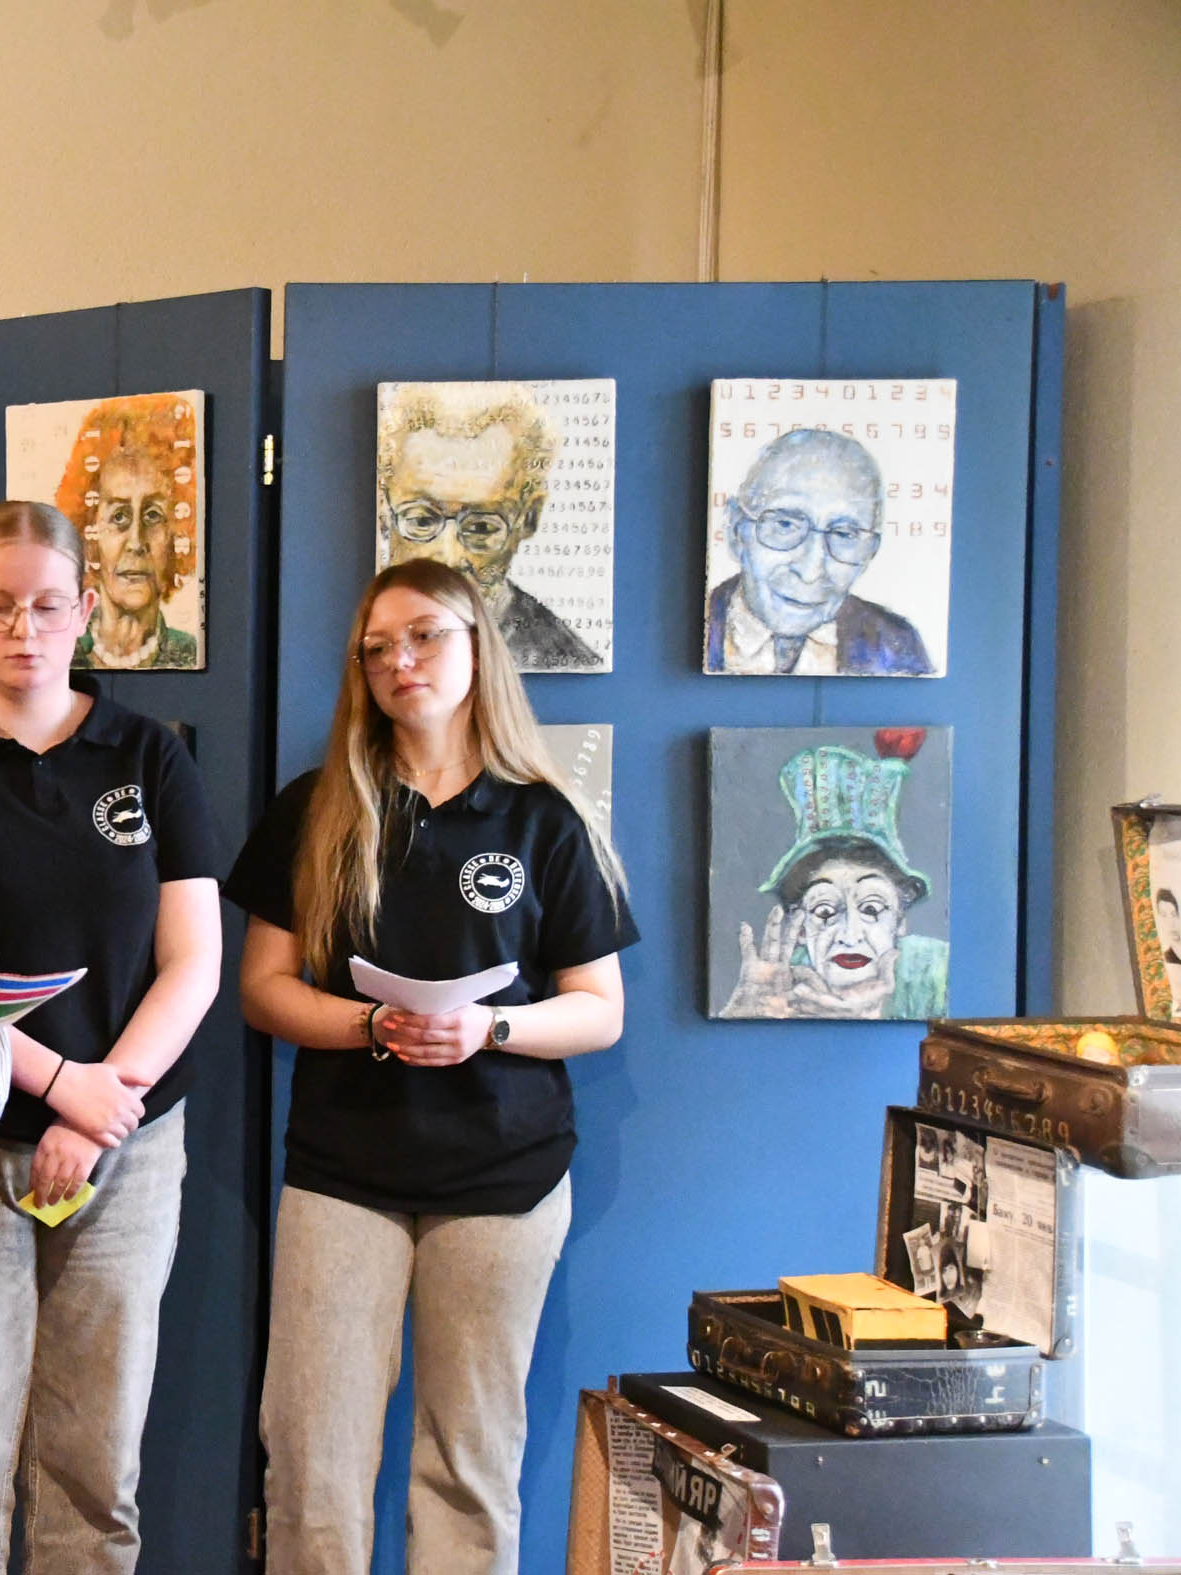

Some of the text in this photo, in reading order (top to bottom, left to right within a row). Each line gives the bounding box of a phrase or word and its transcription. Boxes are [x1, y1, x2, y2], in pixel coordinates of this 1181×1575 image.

[462, 860, 479, 891] CLASSE
[489, 855, 501, 863] DE
[690, 1474, 718, 1516] ЯР
